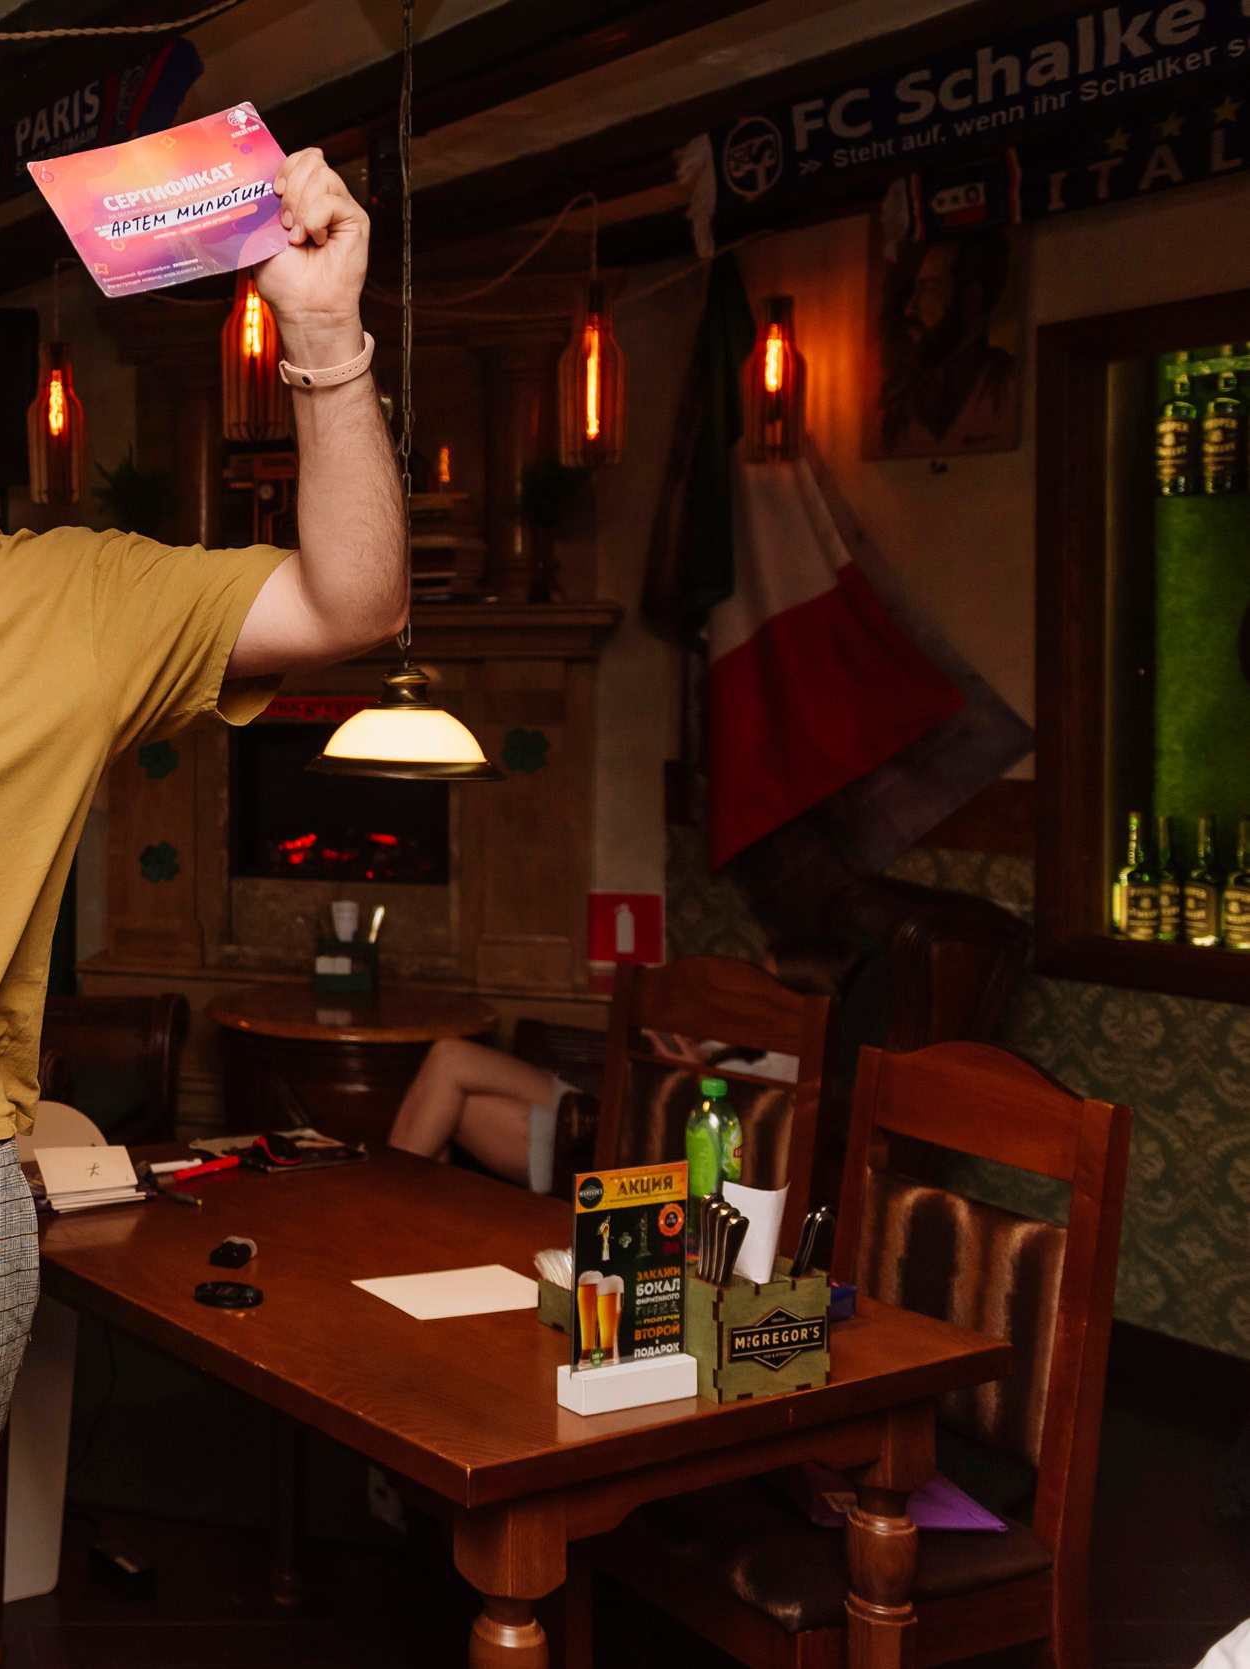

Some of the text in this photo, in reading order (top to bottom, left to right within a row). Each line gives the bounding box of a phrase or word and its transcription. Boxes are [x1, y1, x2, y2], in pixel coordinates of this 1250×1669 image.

[792, 0, 1207, 152] FC Schalke
[15, 80, 100, 157] PARIS
[832, 138, 895, 169] Steht
[901, 122, 947, 151] auf,
[954, 104, 1026, 137] wenn
[1033, 90, 1072, 117] ihr
[1078, 45, 1218, 102] Schalker
[102, 162, 236, 212] СЕРТИФИКАТ
[111, 183, 267, 238] АРТЕМ МИЛЮТИН
[617, 1175, 673, 1197] АКЦИЯ
[636, 1266, 681, 1282] ЗАКАЖИ
[636, 1278, 681, 1297] БОКАЛ
[634, 1321, 680, 1341] ВТОРОЙ
[634, 1342, 680, 1359] ПОДАРОК
